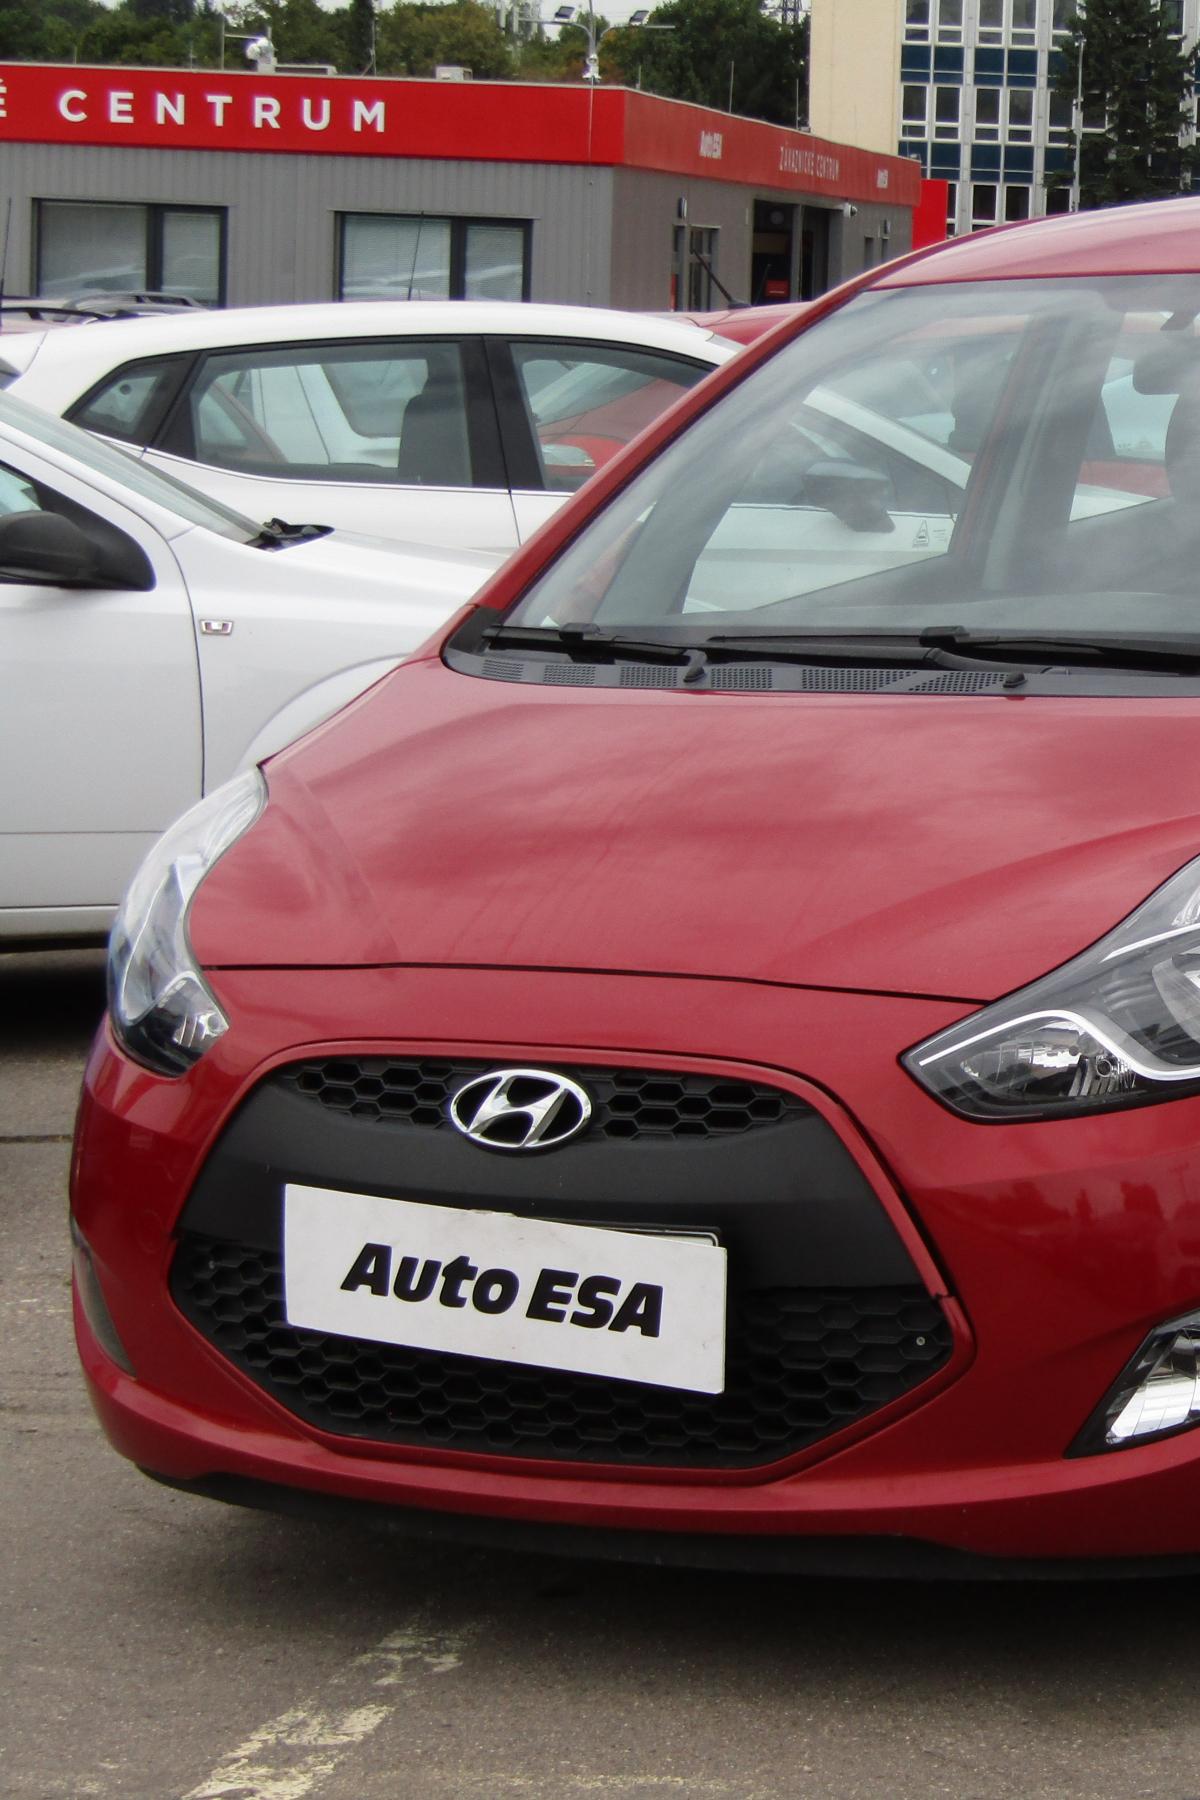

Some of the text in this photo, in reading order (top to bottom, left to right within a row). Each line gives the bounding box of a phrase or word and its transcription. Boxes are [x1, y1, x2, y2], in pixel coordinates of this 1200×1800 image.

[58, 90, 386, 133] CENTRUM
[340, 1242, 664, 1338] Auto ESA
